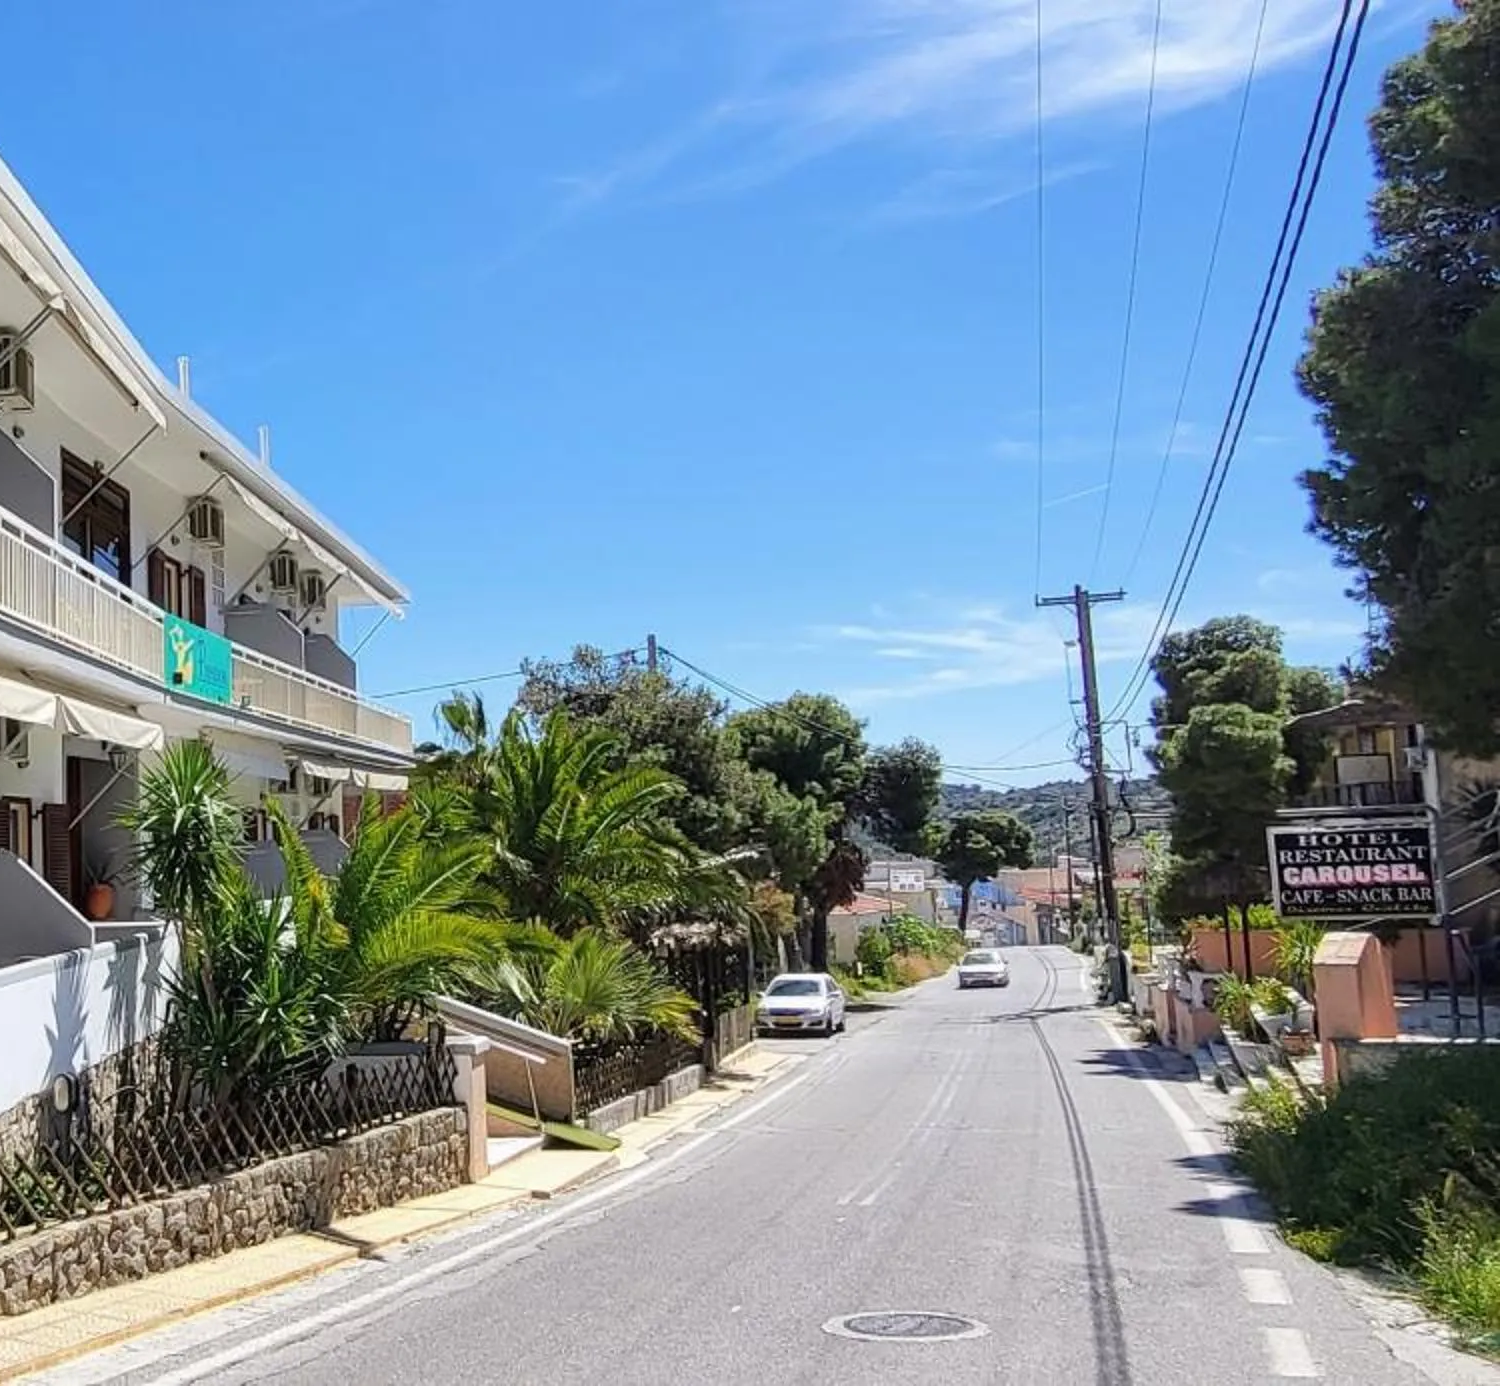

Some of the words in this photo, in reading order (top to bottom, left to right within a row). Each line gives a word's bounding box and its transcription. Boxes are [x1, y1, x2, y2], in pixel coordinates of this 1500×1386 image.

[1299, 832, 1410, 847] HOTEL
[1279, 846, 1428, 865] RESTAURANT
[1283, 863, 1426, 886] CAROUSEL
[1399, 887, 1432, 901] BAR
